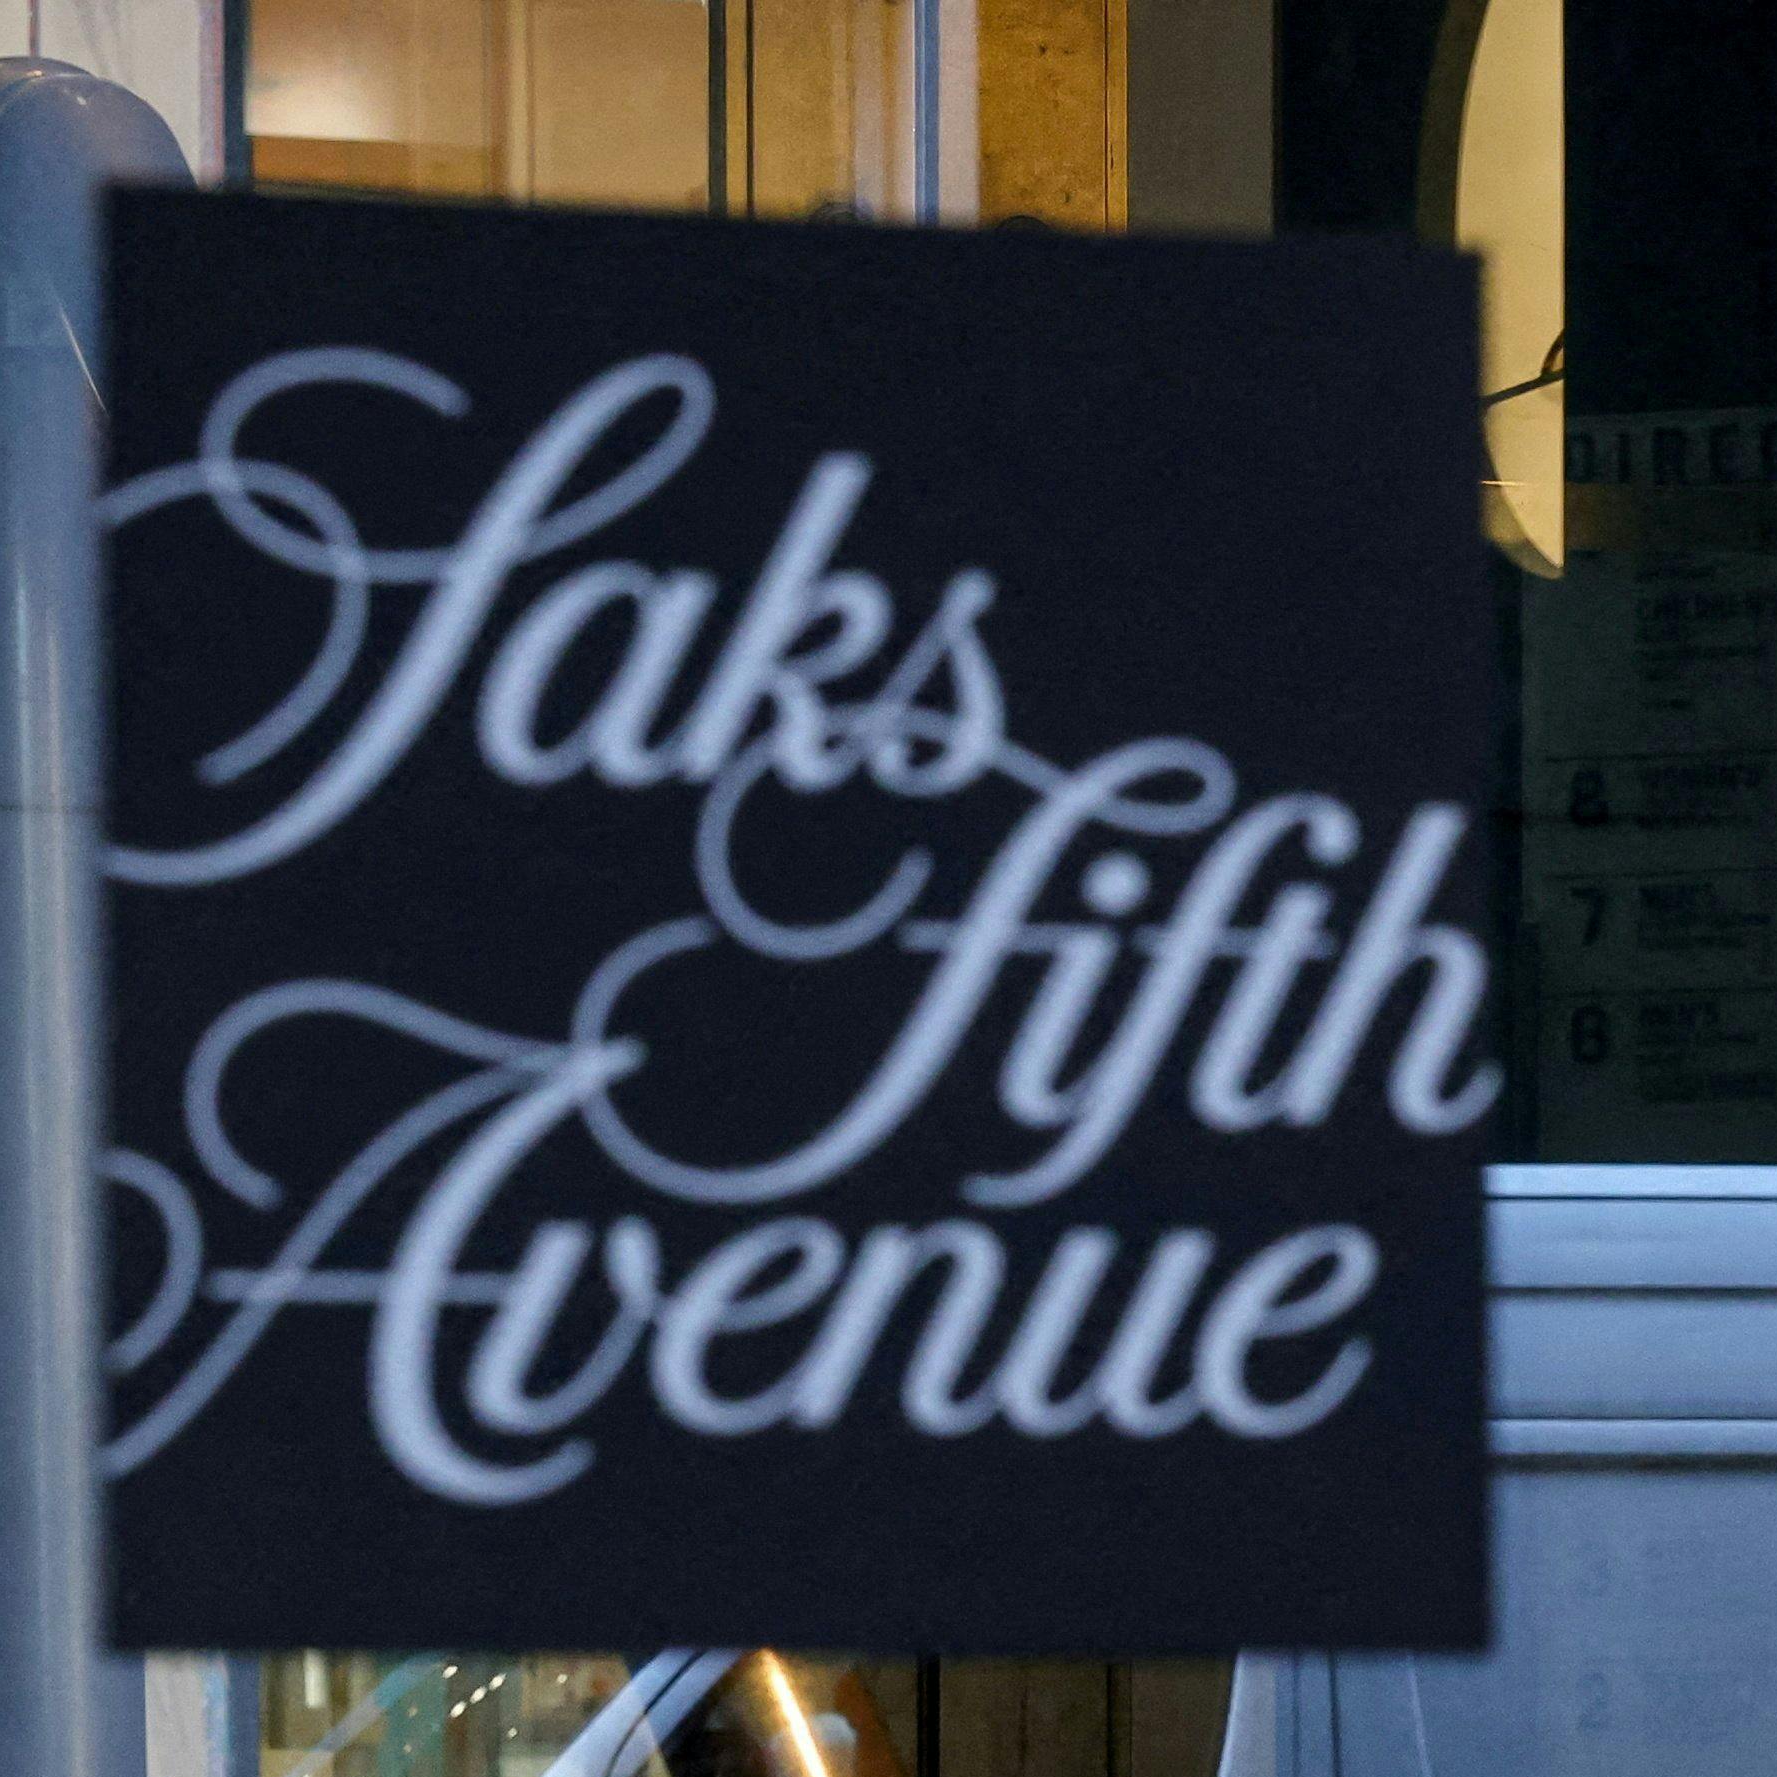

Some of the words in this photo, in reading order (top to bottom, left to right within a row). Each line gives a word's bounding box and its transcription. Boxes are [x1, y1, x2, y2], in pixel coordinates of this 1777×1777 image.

[103, 343, 1013, 890] Saks
[568, 730, 1507, 1208] Fifth
[105, 978, 1381, 1508] Avenue
